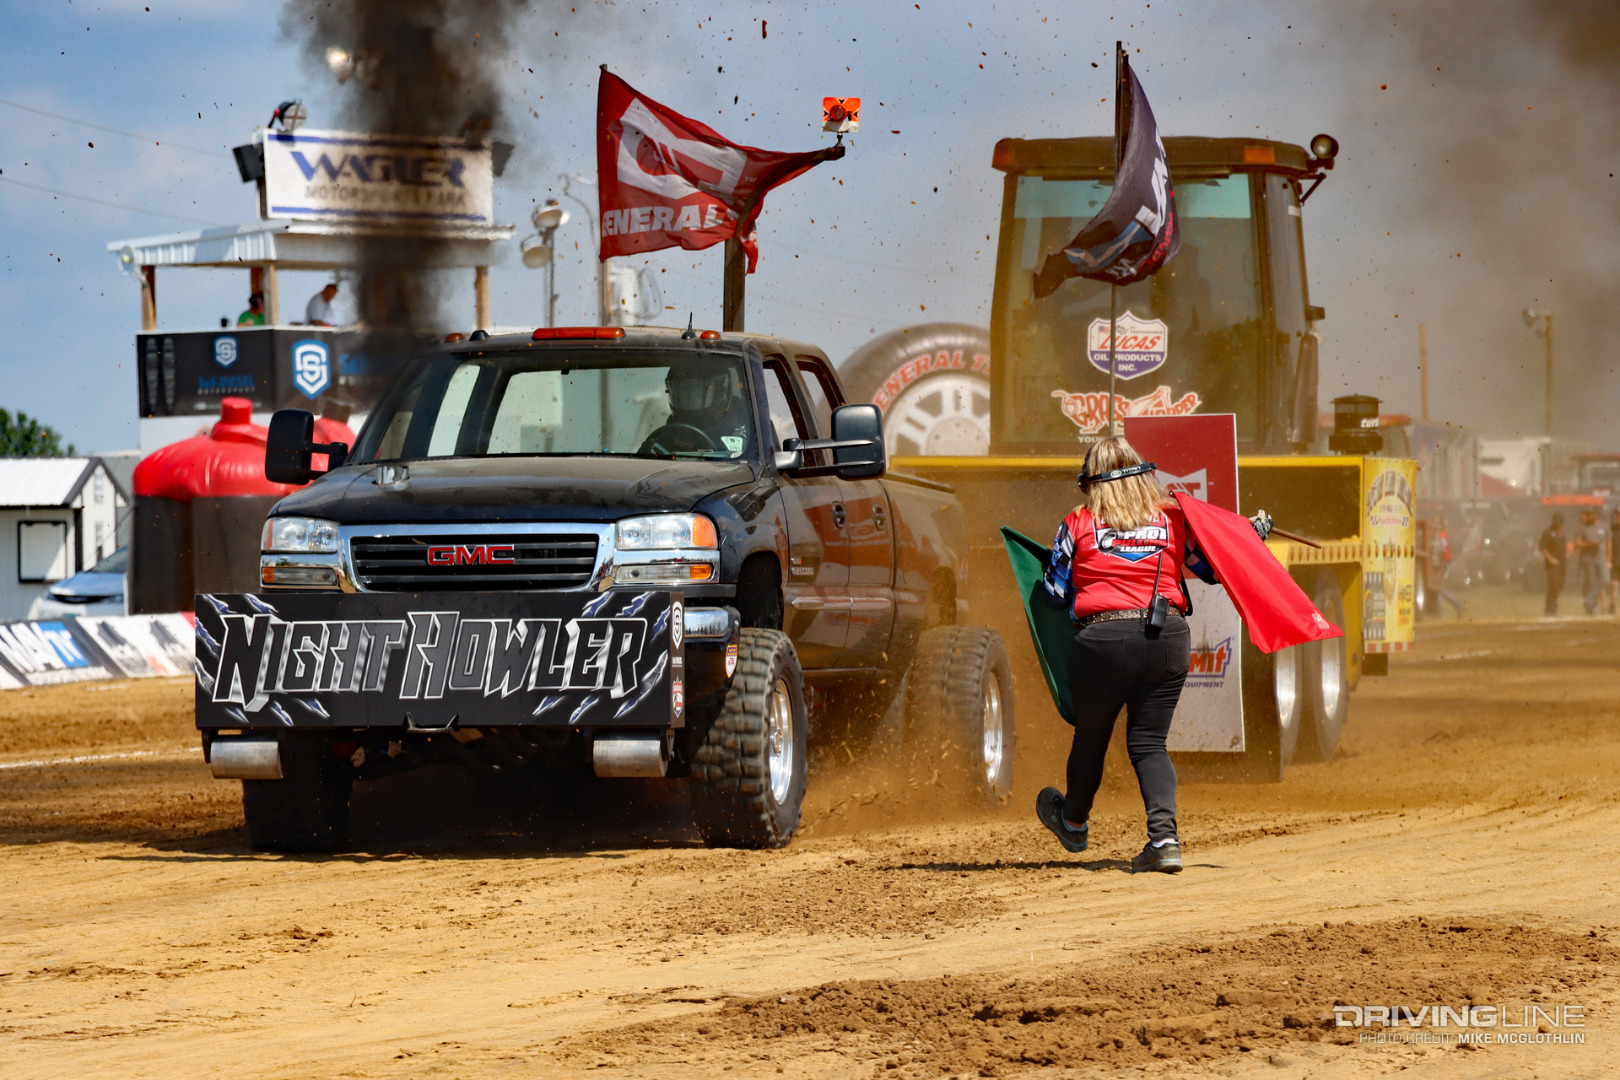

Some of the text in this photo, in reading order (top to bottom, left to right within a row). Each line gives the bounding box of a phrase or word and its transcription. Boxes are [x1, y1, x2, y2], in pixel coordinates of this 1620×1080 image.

[1098, 335, 1162, 350] LUCAS
[1093, 353, 1109, 361] OIL
[1118, 363, 1137, 371] INC.
[871, 349, 967, 414] ENERAL
[1123, 529, 1161, 540] PRO
[427, 544, 515, 566] GMC
[212, 611, 648, 712] NIGHT HOWLER
